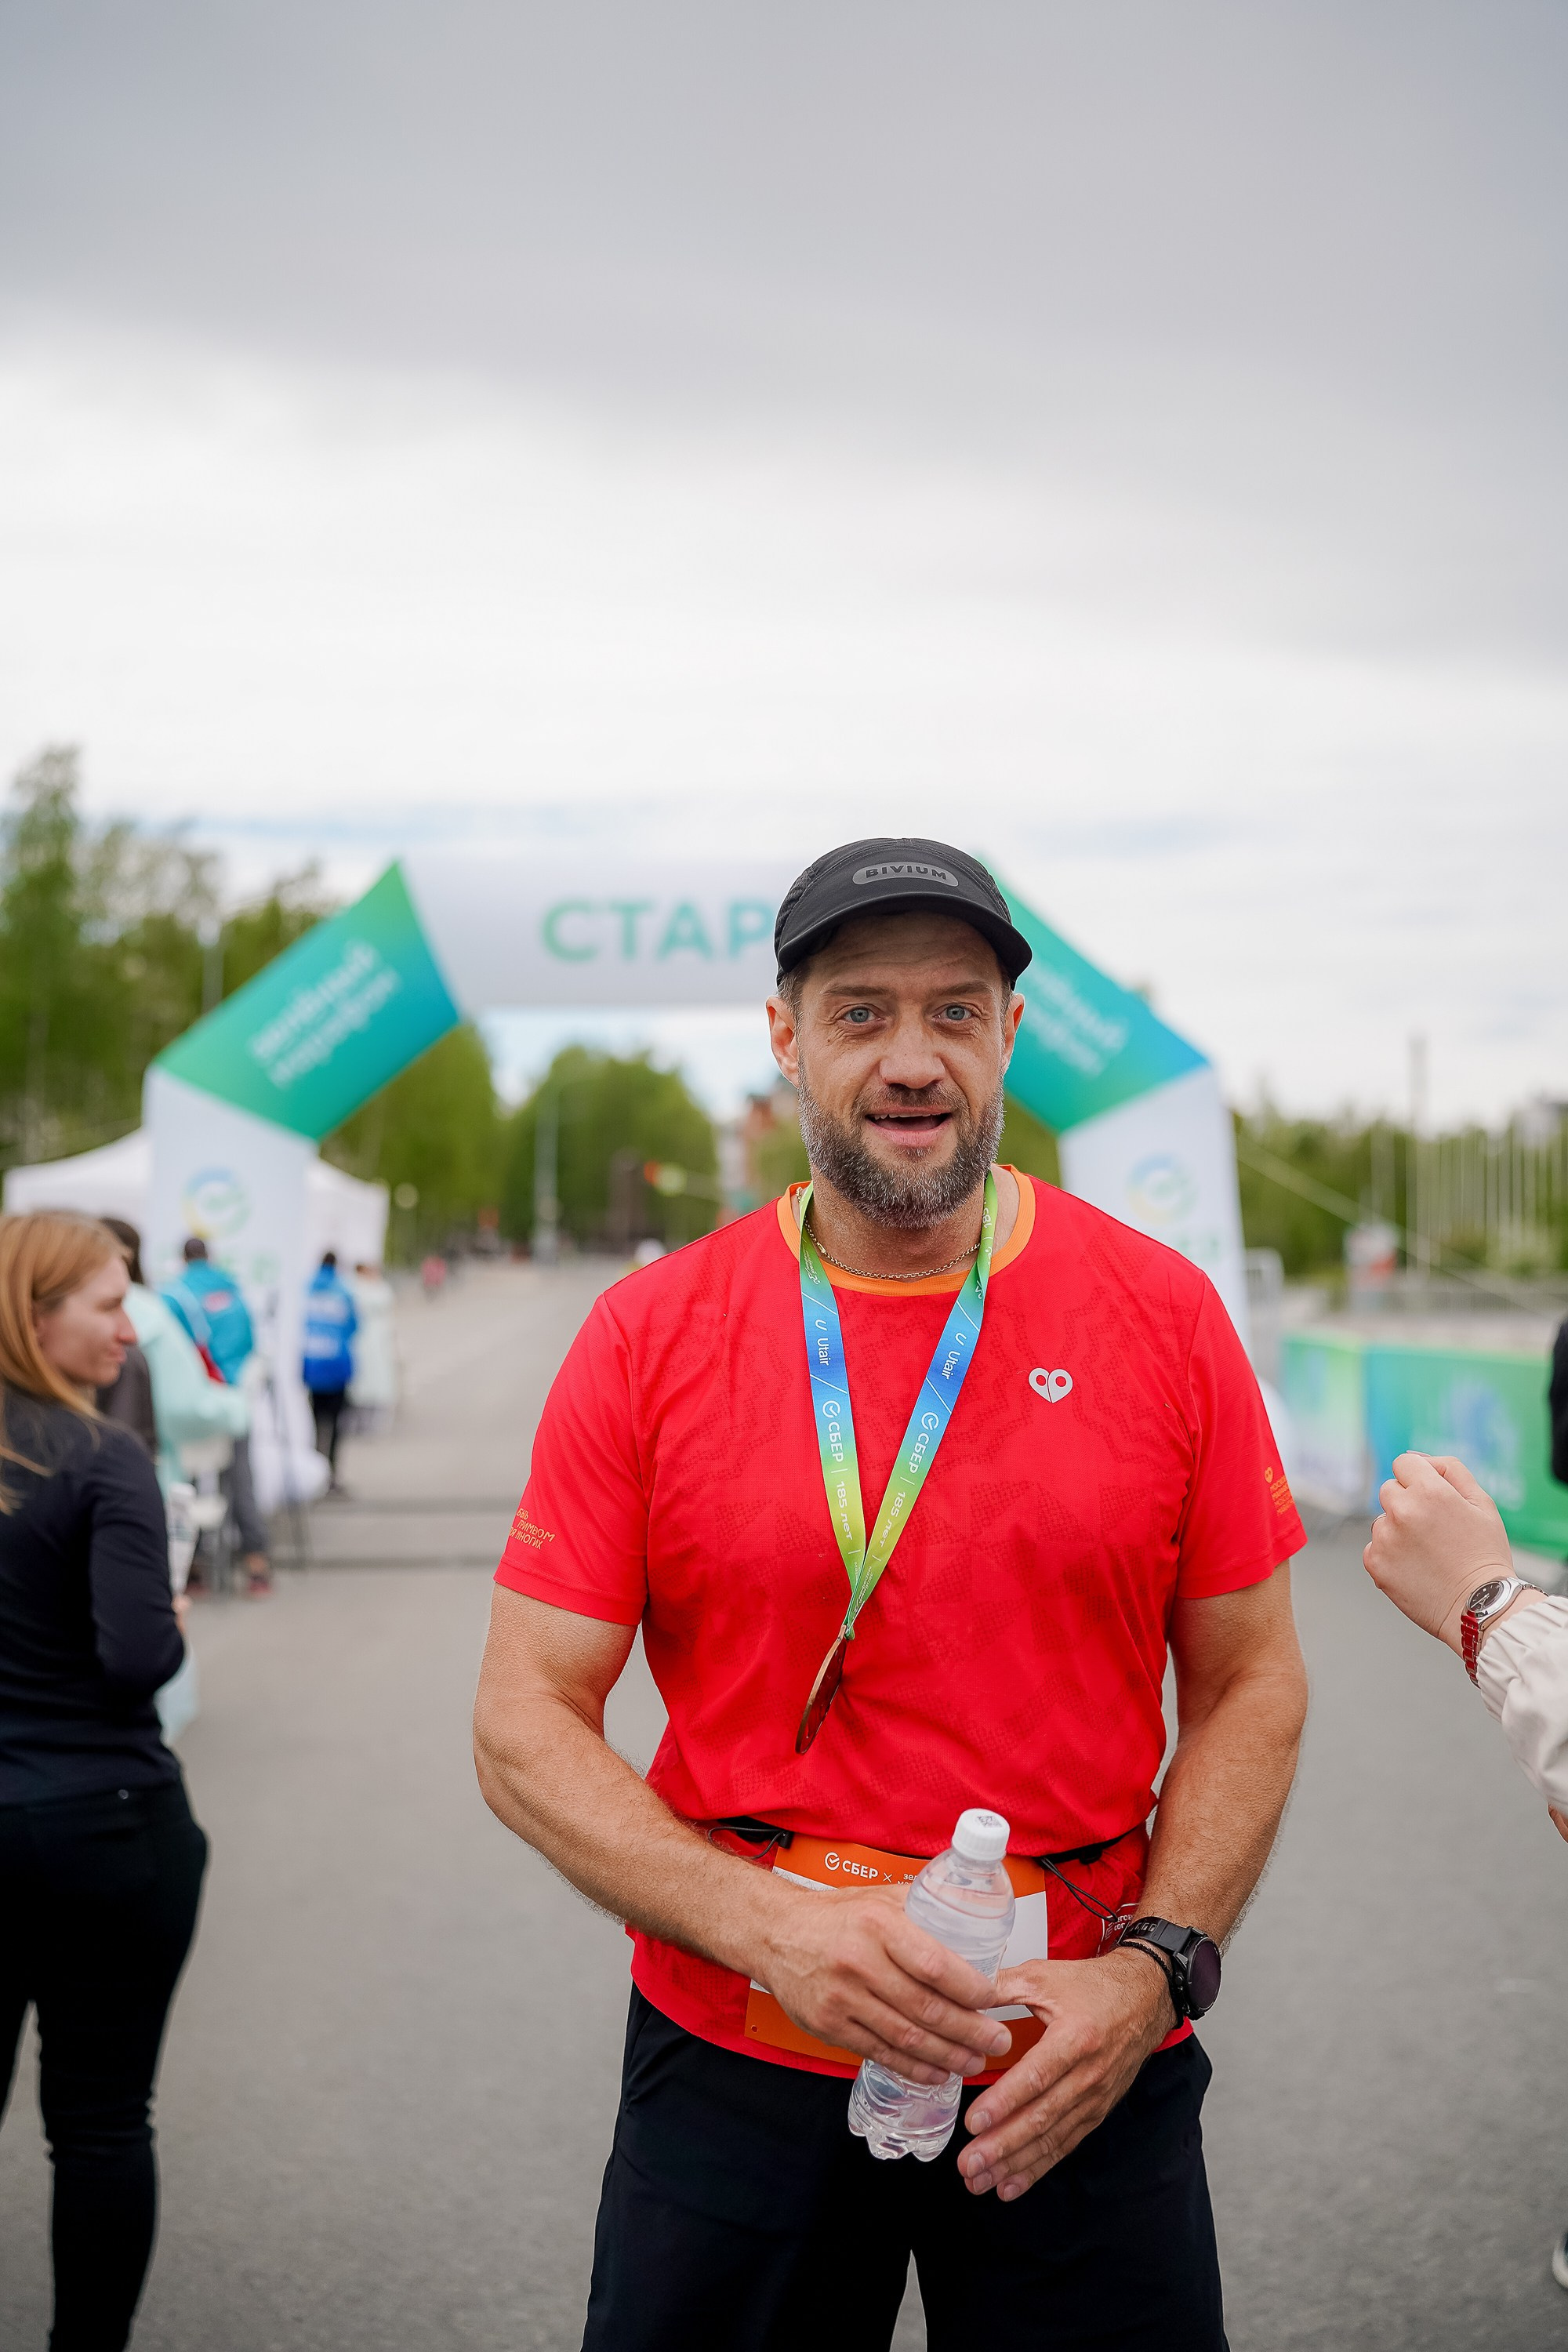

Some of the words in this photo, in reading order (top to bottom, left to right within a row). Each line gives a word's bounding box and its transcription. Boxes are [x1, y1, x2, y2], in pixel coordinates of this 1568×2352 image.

[866, 865, 947, 880] BIVIUM
[542, 898, 776, 962] СТАР
[817, 1337, 829, 1366] Utair
[942, 1350, 961, 1380] Utair
[828, 1421, 844, 1463] СБЕР
[909, 1432, 930, 1475] СБЕР
[836, 1481, 848, 1508] 185
[891, 1491, 906, 1518] 185
[840, 1512, 853, 1541] лет
[879, 1519, 893, 1548] лет
[842, 1860, 879, 1879] СБЕР
